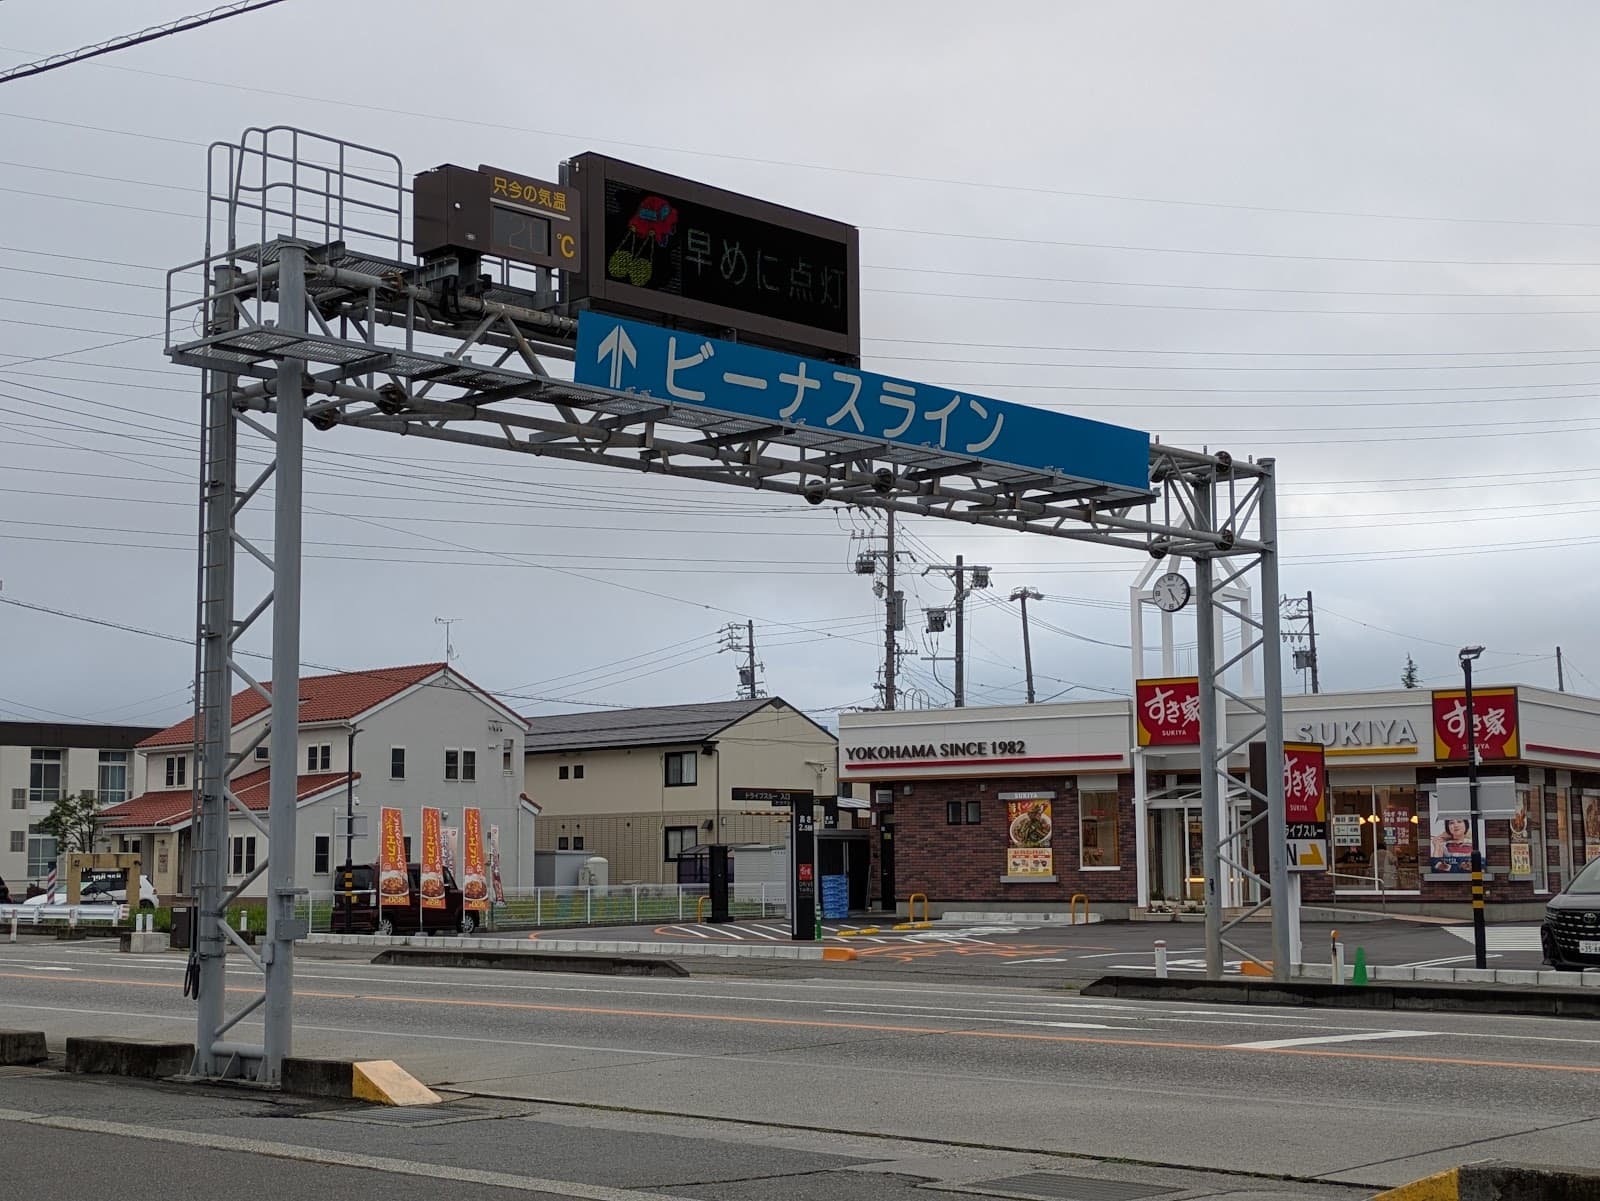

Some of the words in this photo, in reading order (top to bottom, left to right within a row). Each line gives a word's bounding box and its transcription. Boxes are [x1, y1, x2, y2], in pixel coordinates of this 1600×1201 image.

[493, 176, 567, 212] 只今の気温
[685, 227, 844, 309] 早めに点灯
[665, 335, 1005, 453] ビーナスライン
[1144, 686, 1200, 727] すき家
[1442, 699, 1507, 741] すき家
[845, 743, 937, 760] YOKOHAMA
[940, 742, 987, 757] SINCE
[991, 740, 1026, 755] 1982
[1299, 719, 1418, 746] SUKIYA
[1014, 791, 1038, 799] SUKIYA
[1284, 752, 1318, 802] すき家
